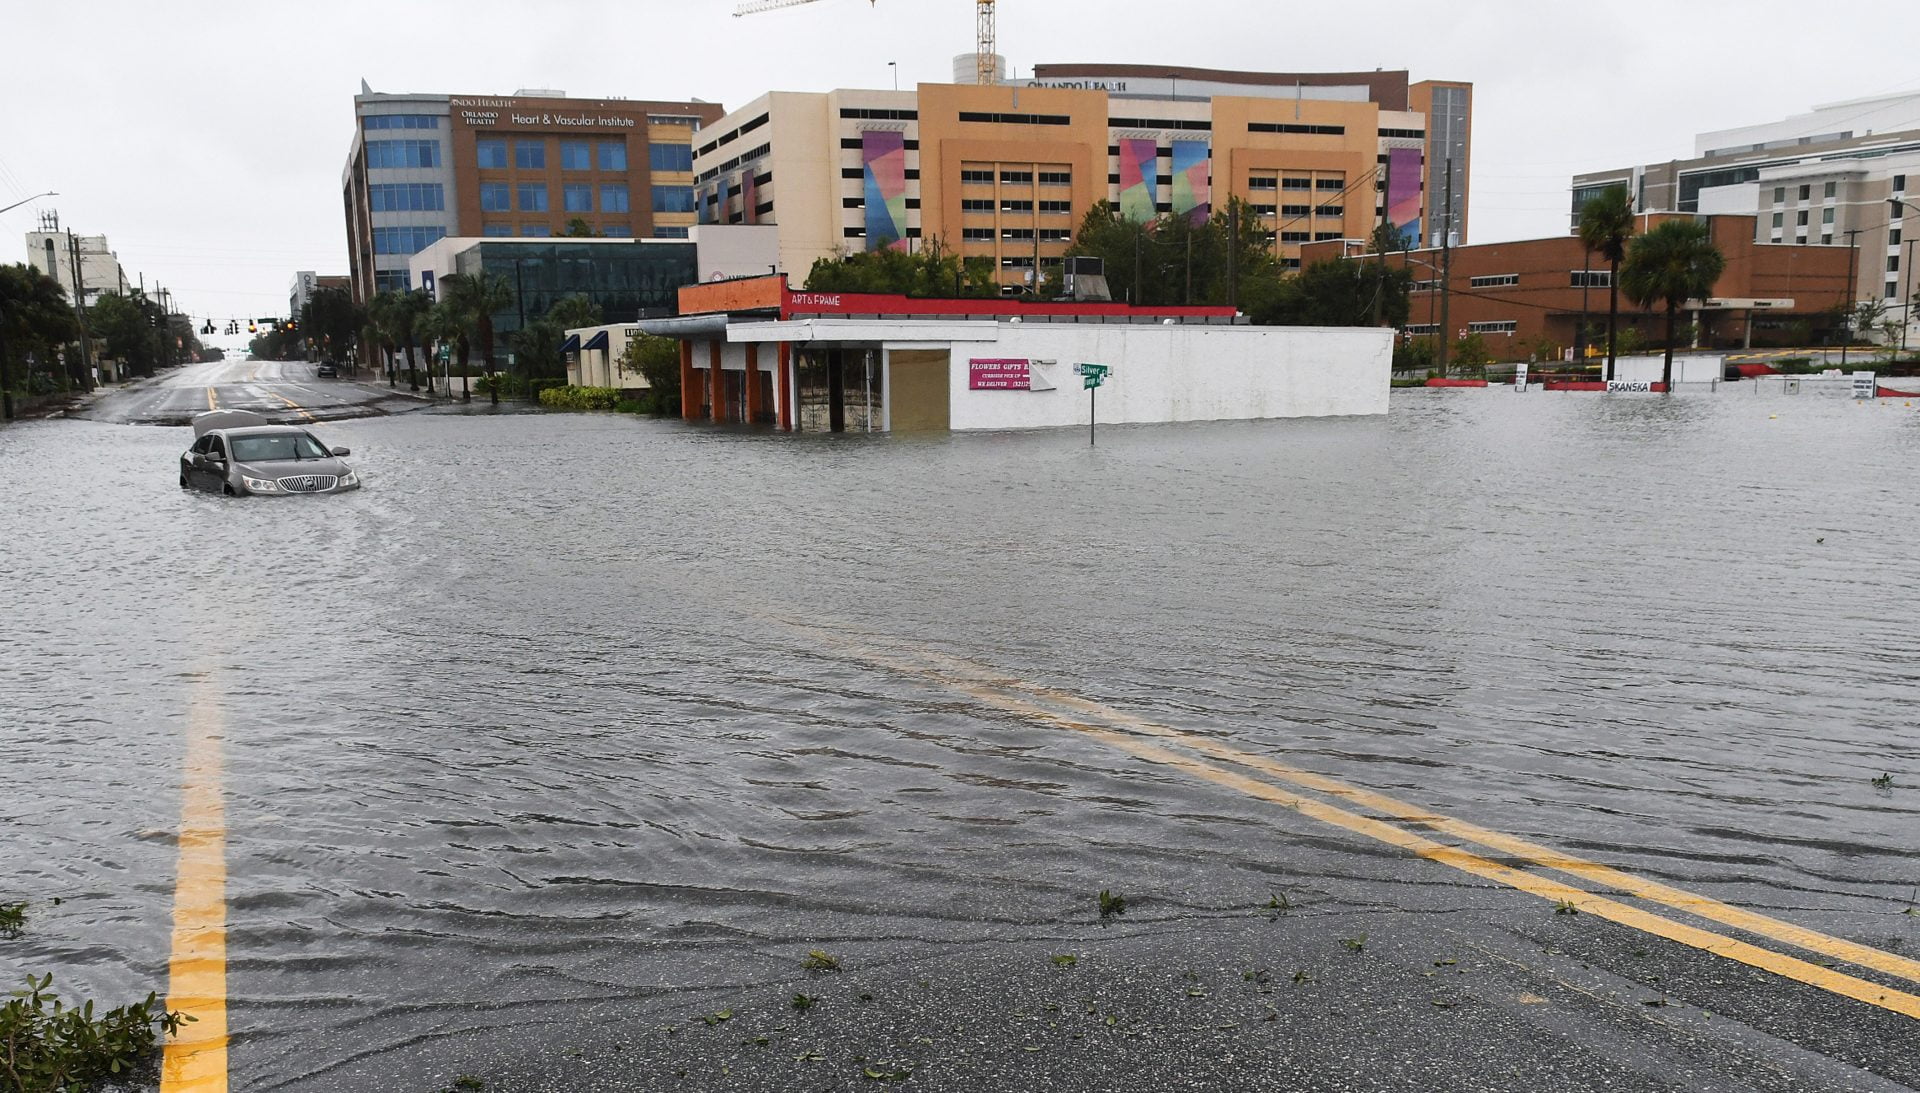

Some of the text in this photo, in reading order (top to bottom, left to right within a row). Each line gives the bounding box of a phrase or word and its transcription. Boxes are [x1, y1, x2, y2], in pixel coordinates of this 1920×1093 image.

[461, 110, 499, 118] ORLANDO
[511, 113, 634, 127] Heart & Vascular Institute
[791, 294, 807, 304] ART
[814, 294, 840, 306] FRAME
[1081, 365, 1100, 375] Silver
[1609, 381, 1648, 392] SKANSKA
